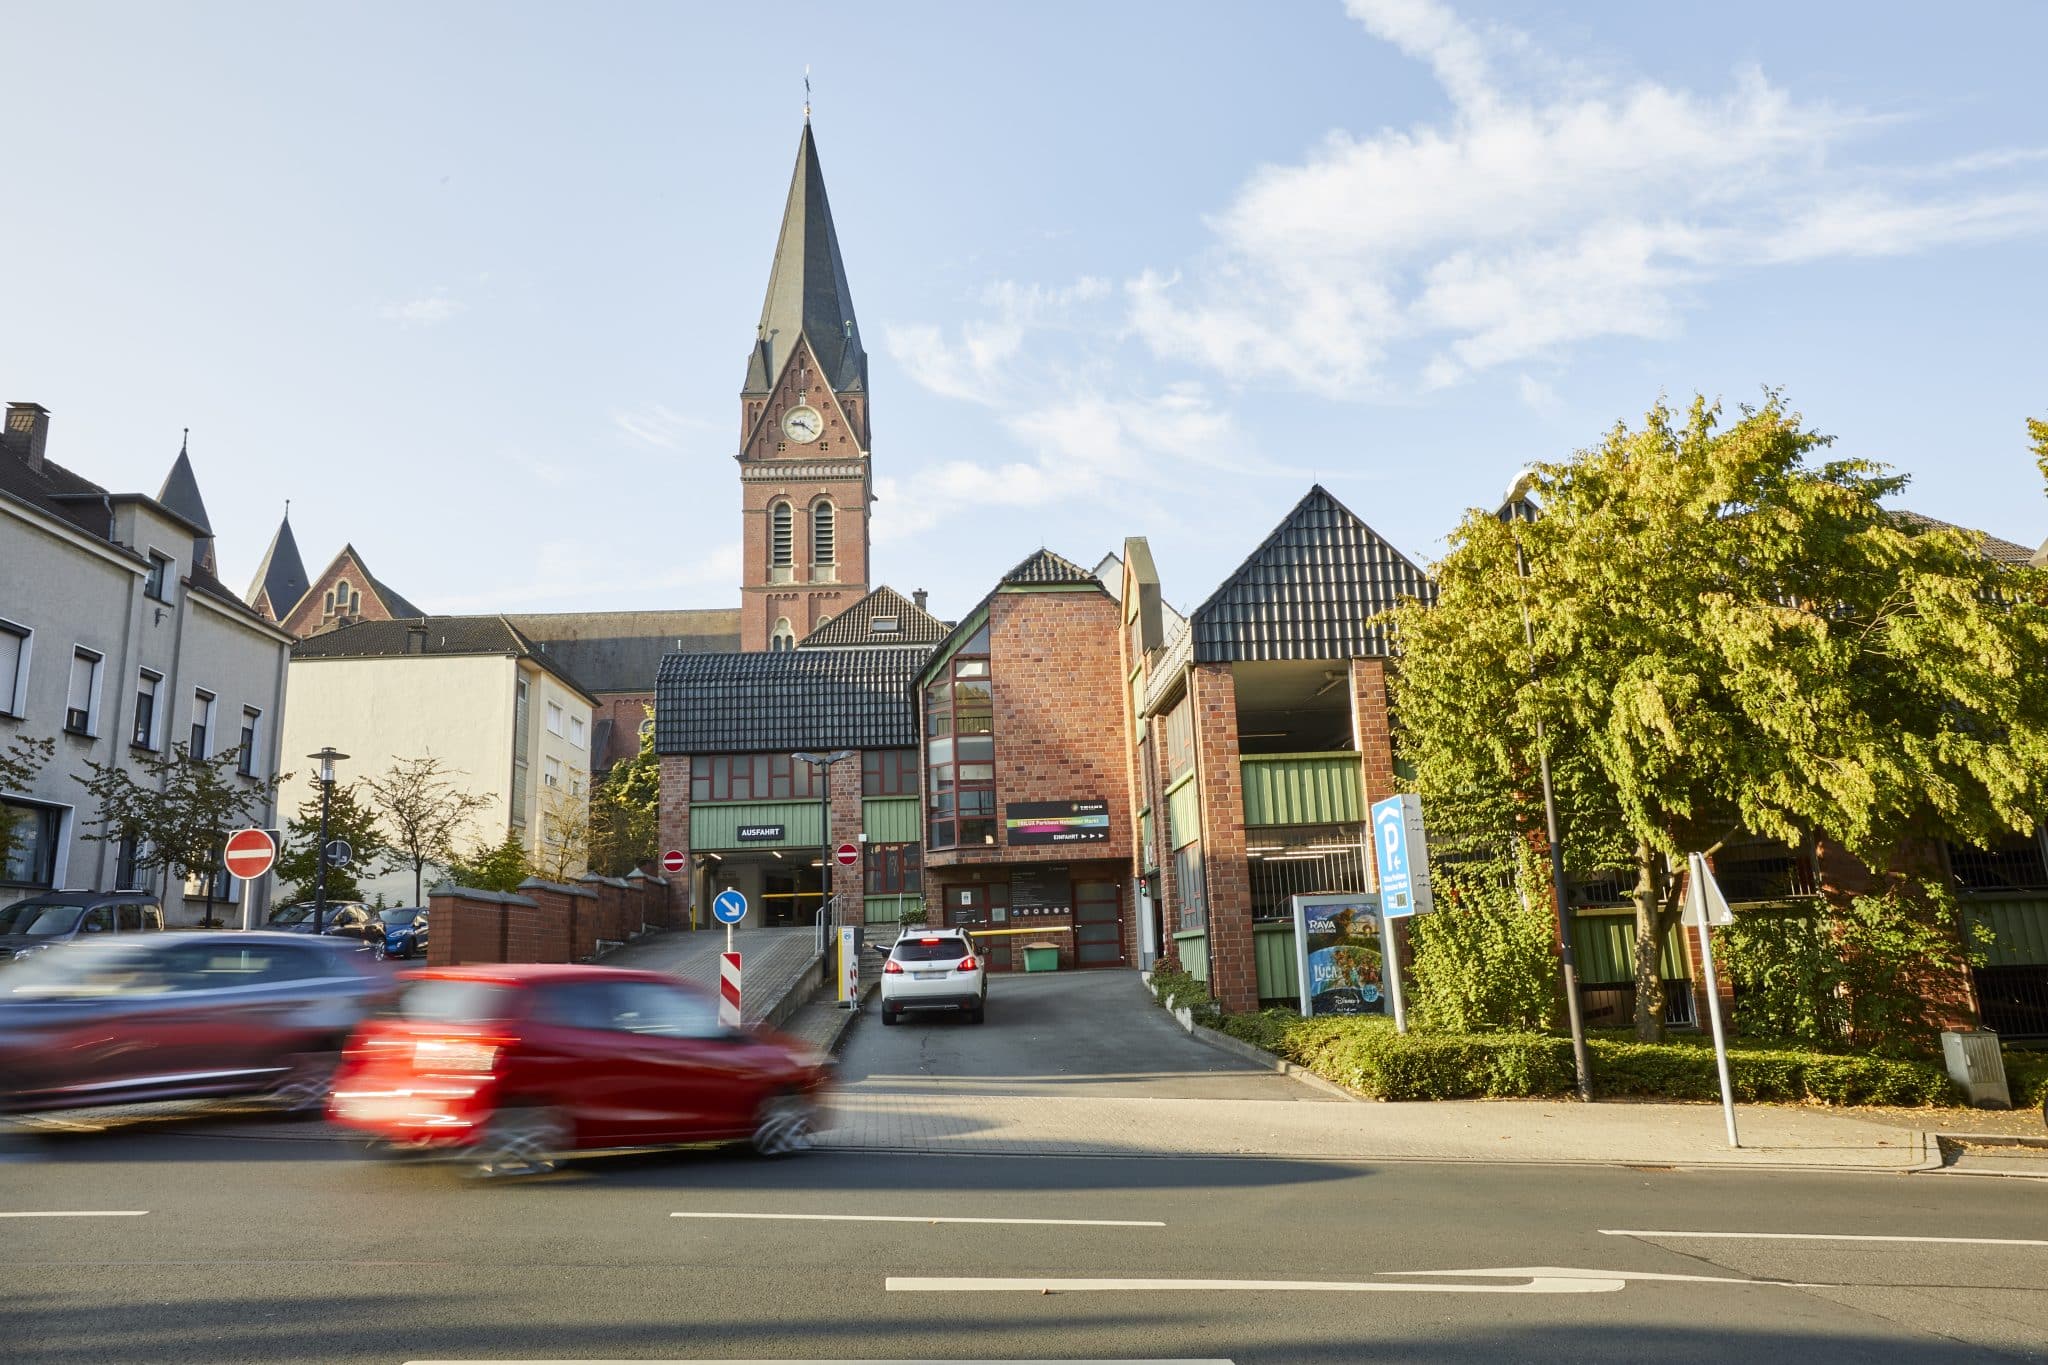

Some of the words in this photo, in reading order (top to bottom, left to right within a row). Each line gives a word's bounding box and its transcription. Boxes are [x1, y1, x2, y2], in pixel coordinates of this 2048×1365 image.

[741, 828, 780, 836] AUSFAHRT
[1384, 822, 1399, 871] P
[1314, 964, 1337, 981] LUCA
